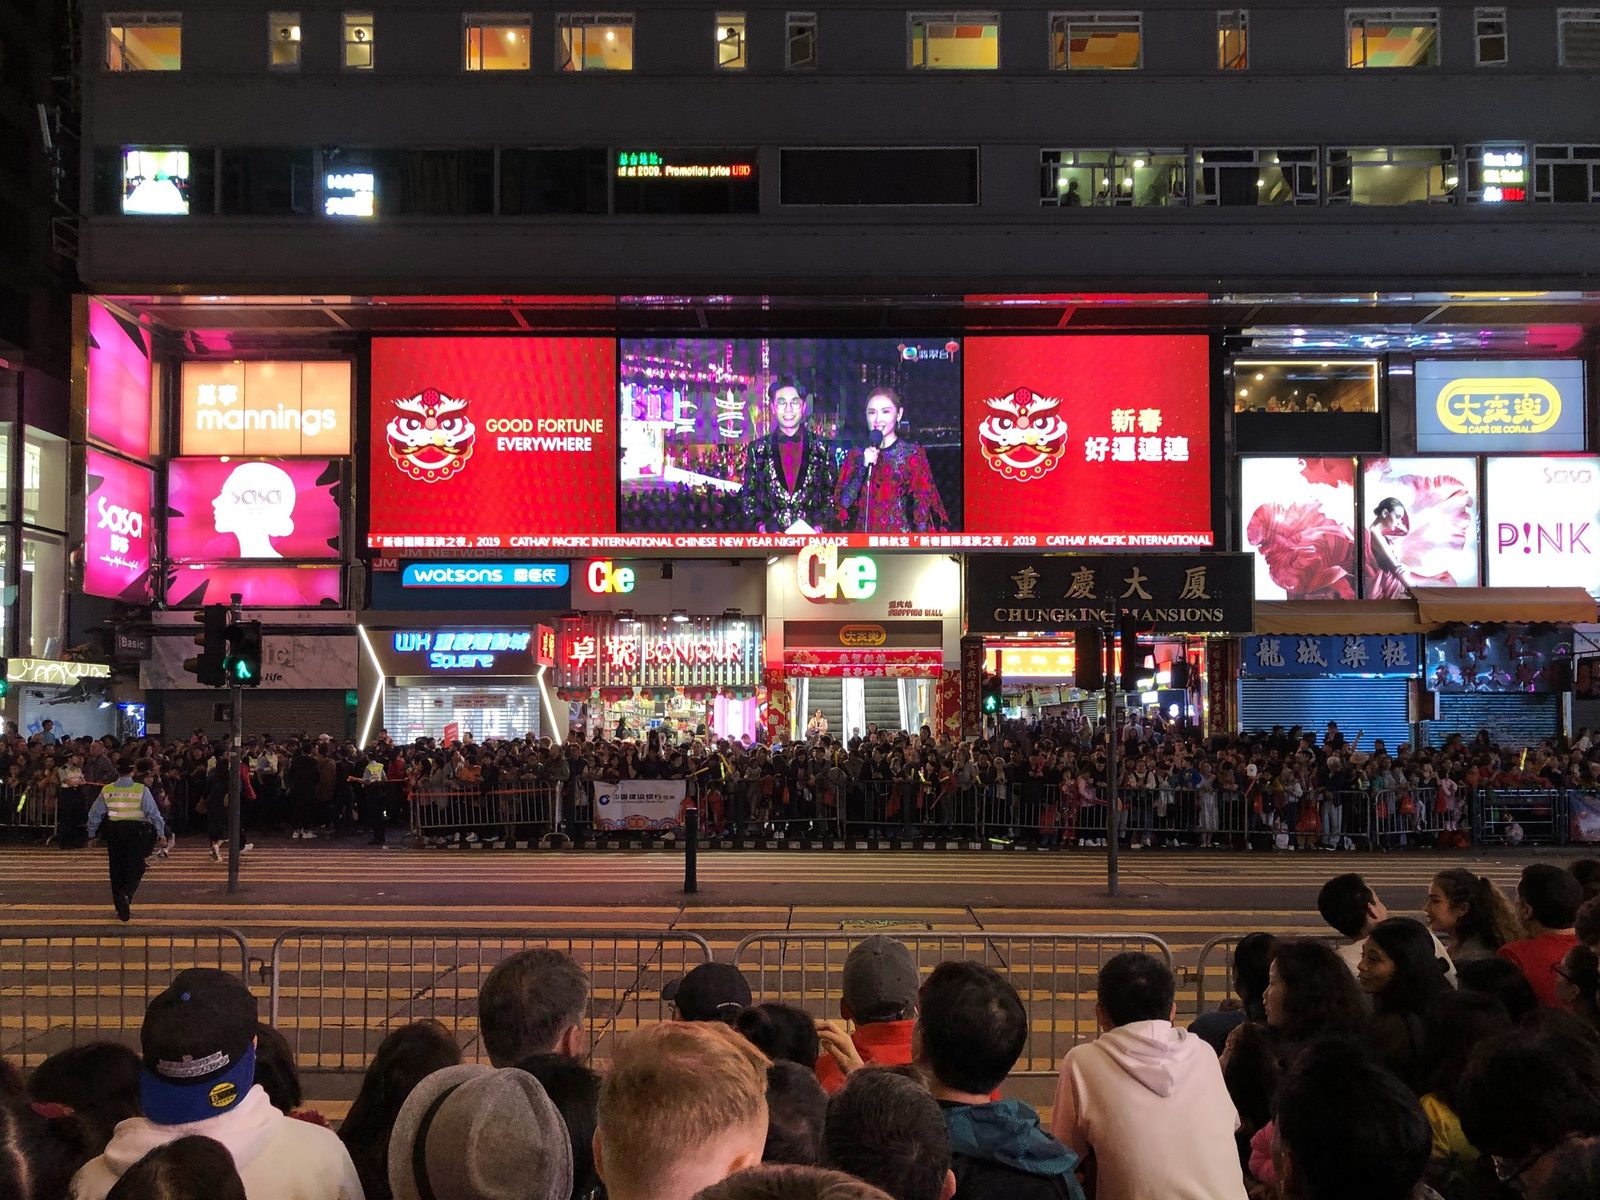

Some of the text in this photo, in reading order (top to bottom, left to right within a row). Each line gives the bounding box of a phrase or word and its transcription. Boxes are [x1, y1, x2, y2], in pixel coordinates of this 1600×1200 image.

[665, 165, 708, 177] Promotion
[710, 166, 730, 178] price
[732, 165, 750, 176] USD
[196, 402, 337, 437] mannings
[485, 418, 604, 434] GOOD FORTUNE
[1111, 408, 1163, 434] 新春
[1503, 425, 1533, 434] CORAL
[496, 437, 593, 452] EVERYWHERE
[1084, 436, 1190, 462] 好運連連
[476, 536, 501, 548] 2019
[509, 536, 849, 548] CATHAY PACIFIC INTERNATIONAL CHINESE NEW YEAR NIGHT PARADE
[1012, 535, 1037, 546] 2019
[1046, 535, 1212, 546] CATHAY PACIFIC INTERNATIONAL
[1497, 522, 1592, 555] P!NK
[400, 548, 423, 558] JM
[427, 548, 507, 558] NETWORK
[373, 558, 397, 568] JM
[414, 566, 503, 583] watsons
[924, 608, 943, 616] MALL
[645, 640, 742, 662] BONJOUR
[429, 652, 494, 669] Square
[264, 672, 283, 682] life
